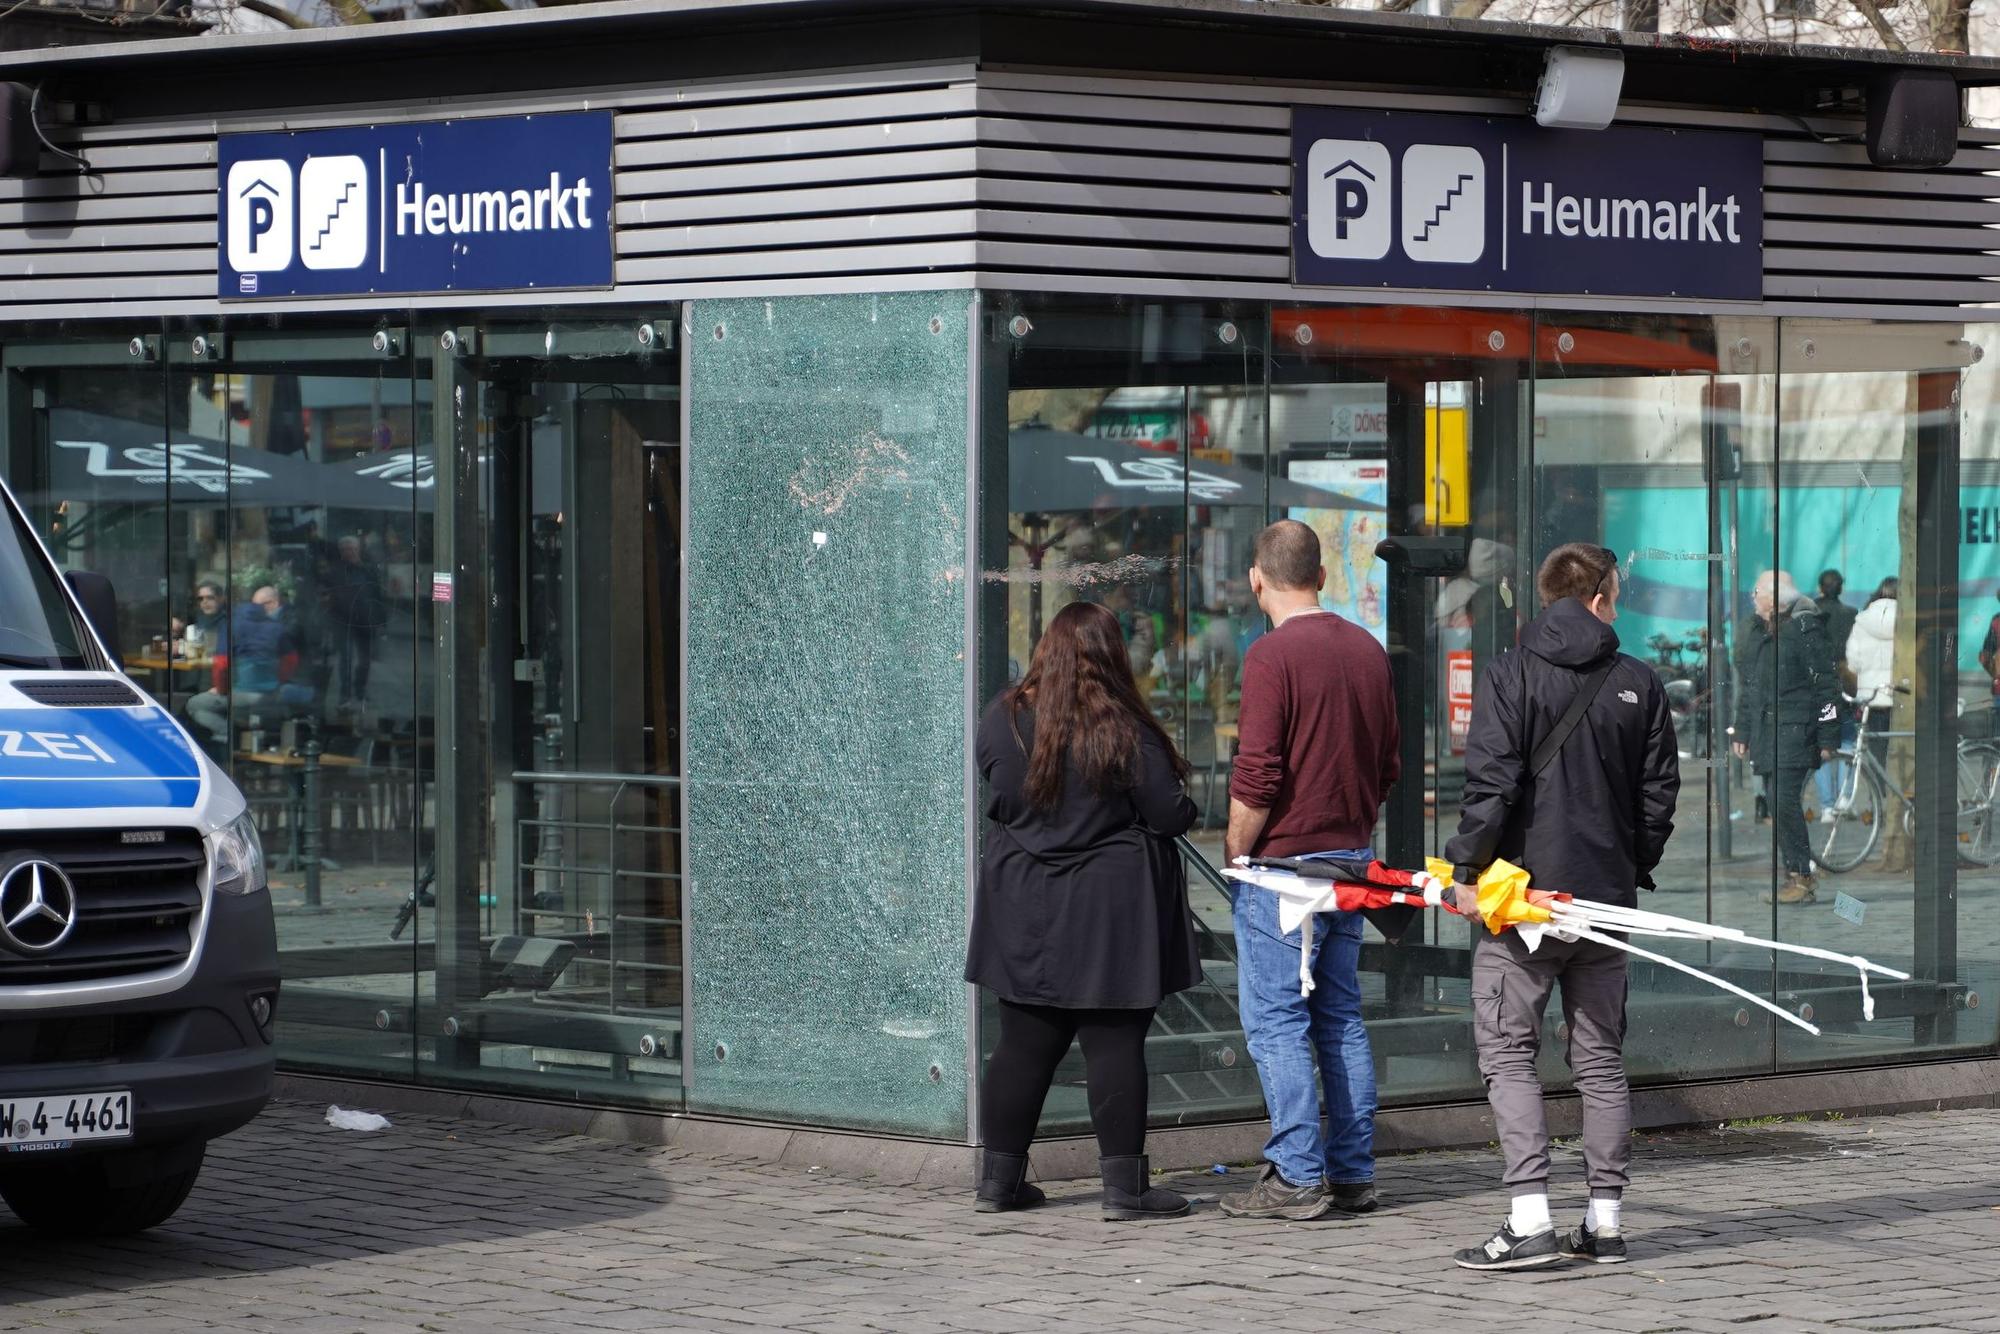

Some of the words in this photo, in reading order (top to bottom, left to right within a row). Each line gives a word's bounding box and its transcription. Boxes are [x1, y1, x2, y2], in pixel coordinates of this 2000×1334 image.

[249, 197, 273, 254] P
[396, 172, 592, 236] Heumarkt
[1335, 178, 1368, 240] P
[1522, 181, 1741, 243] Heumarkt
[0, 730, 116, 763] ZEI
[32, 1095, 129, 1135] 4-4461
[20, 1142, 61, 1152] MOSOLF
[1484, 1236, 1510, 1260] N
